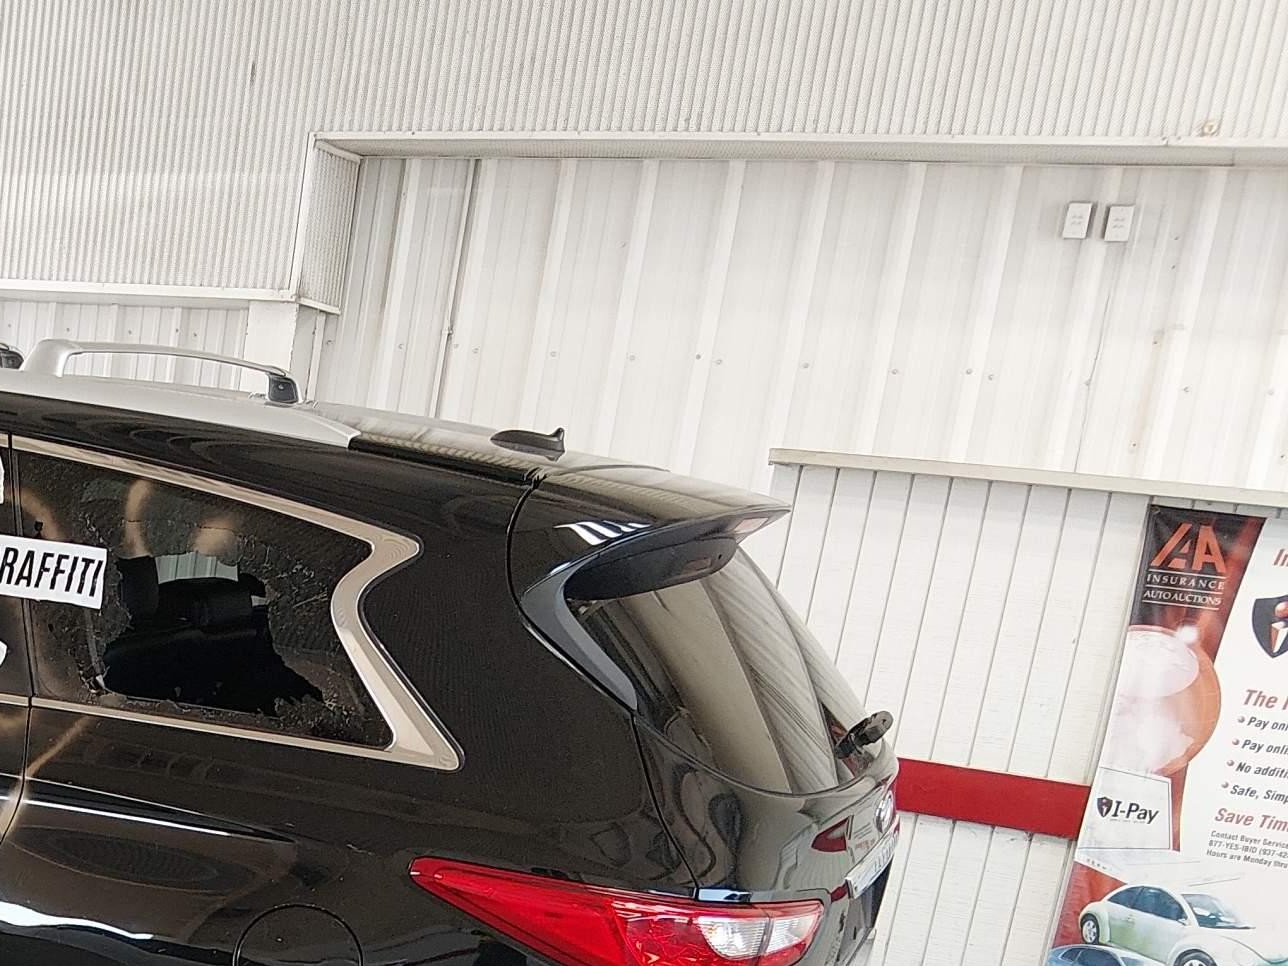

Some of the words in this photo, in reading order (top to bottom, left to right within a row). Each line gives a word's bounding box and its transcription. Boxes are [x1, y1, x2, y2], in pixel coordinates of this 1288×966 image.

[1146, 574, 1225, 590] INSURANCE
[1143, 590, 1171, 600] AUTO
[1171, 592, 1222, 606] AUCTIONS
[1243, 689, 1279, 709] The
[1247, 716, 1270, 730] Pay
[1241, 739, 1265, 753] Pay
[1235, 761, 1252, 774] No
[1230, 784, 1259, 800] Safe,
[1111, 800, 1159, 824] I-Pay
[1215, 807, 1254, 826] Save
[1259, 814, 1288, 833] Tim
[1211, 830, 1238, 841] Contact
[1240, 835, 1261, 845] Buyer
[1206, 849, 1227, 859] Hours
[1243, 855, 1272, 867] Monday
